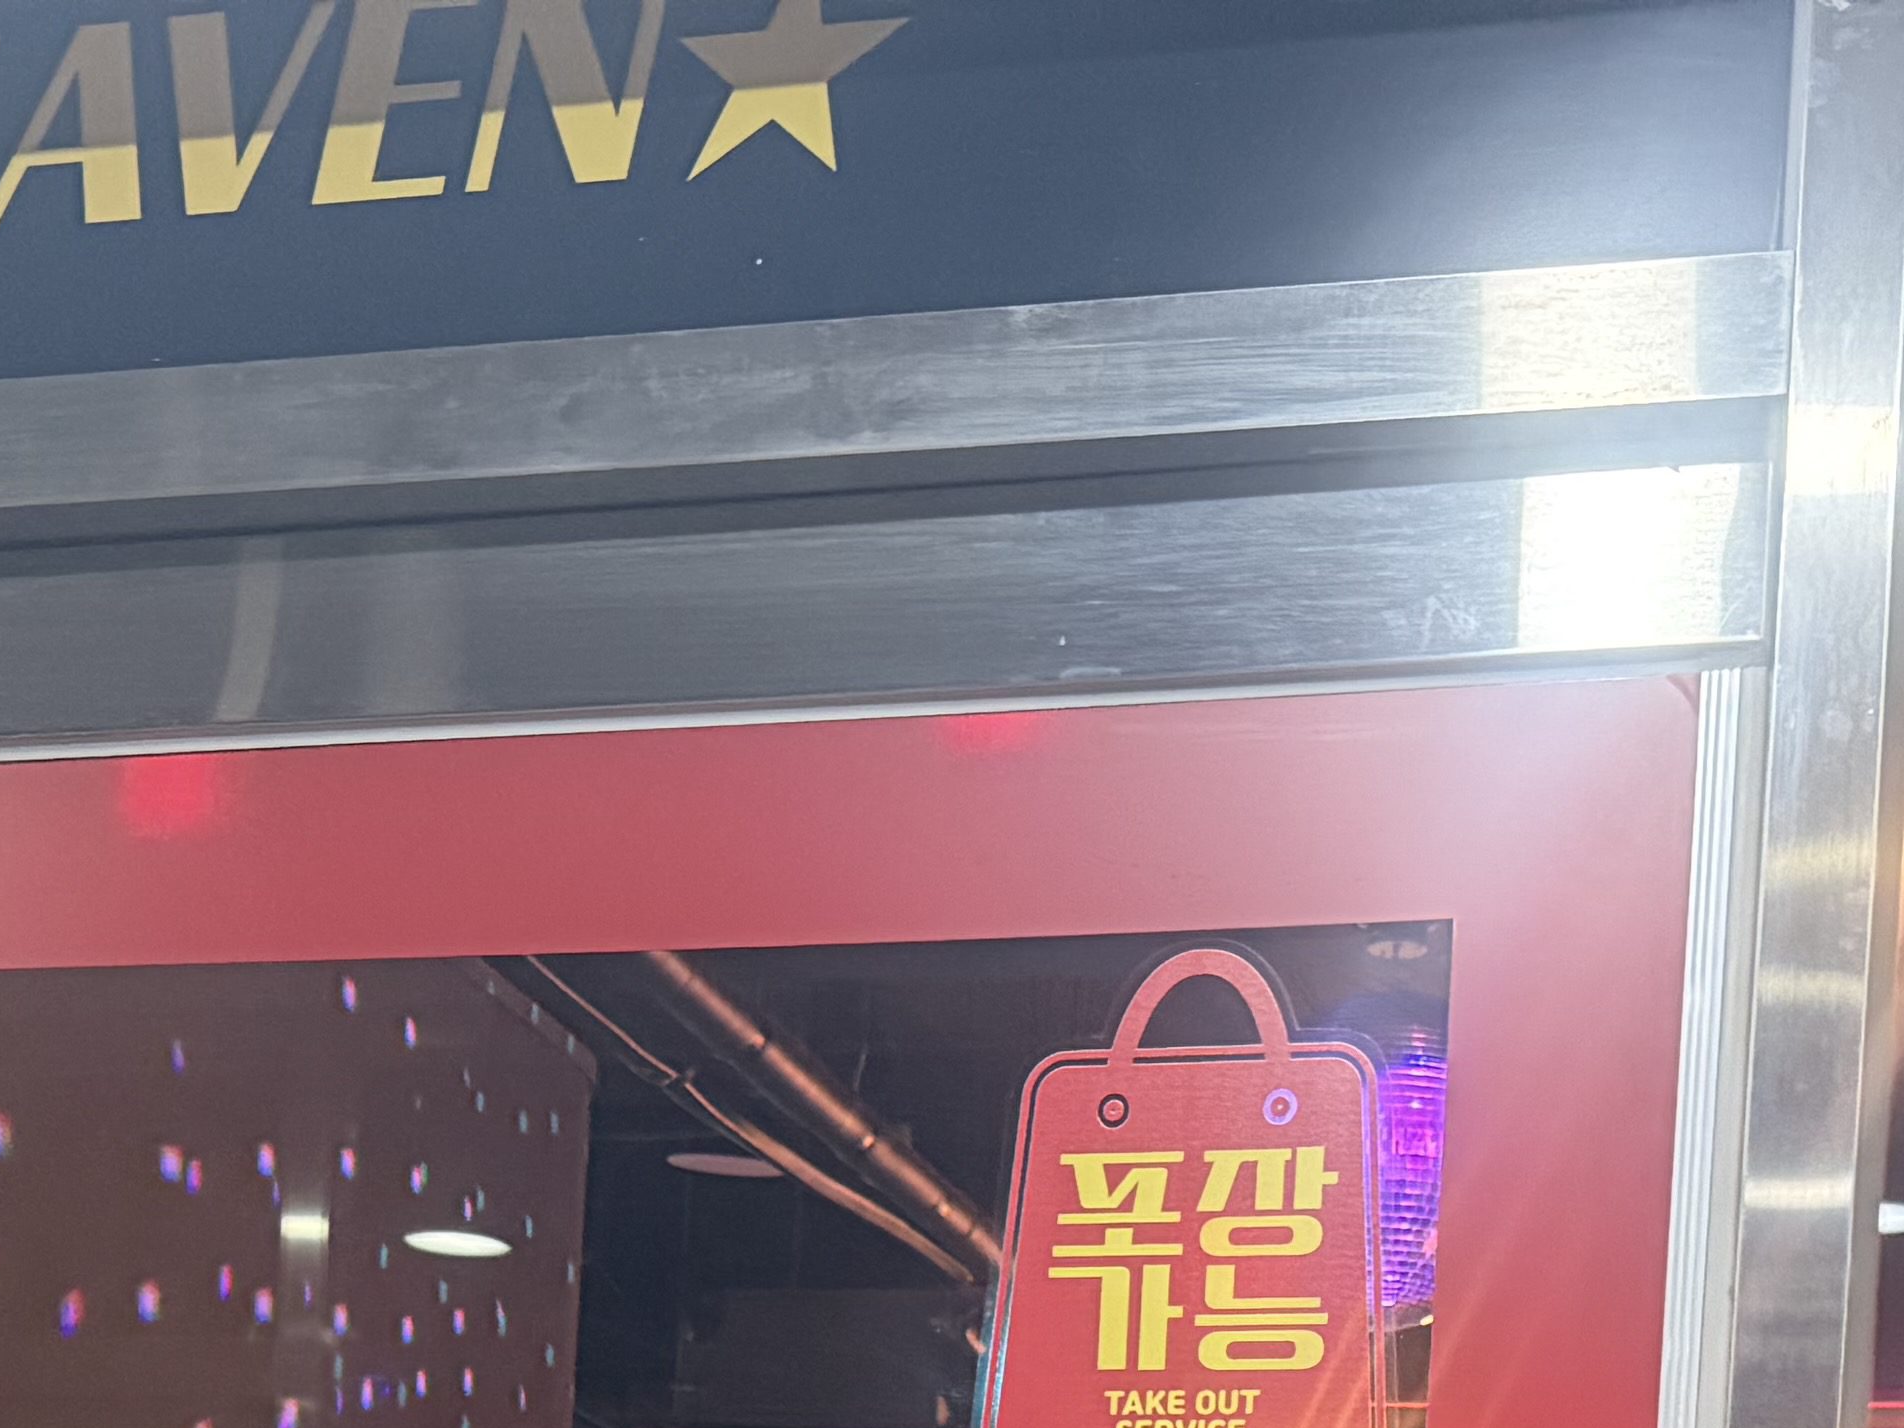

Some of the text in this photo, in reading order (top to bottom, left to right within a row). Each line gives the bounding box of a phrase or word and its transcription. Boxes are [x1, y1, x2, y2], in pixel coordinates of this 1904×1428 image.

[1052, 1146, 1339, 1258] 포장
[1048, 1264, 1329, 1371] 가능
[1104, 1389, 1261, 1416] TAKE OUT
